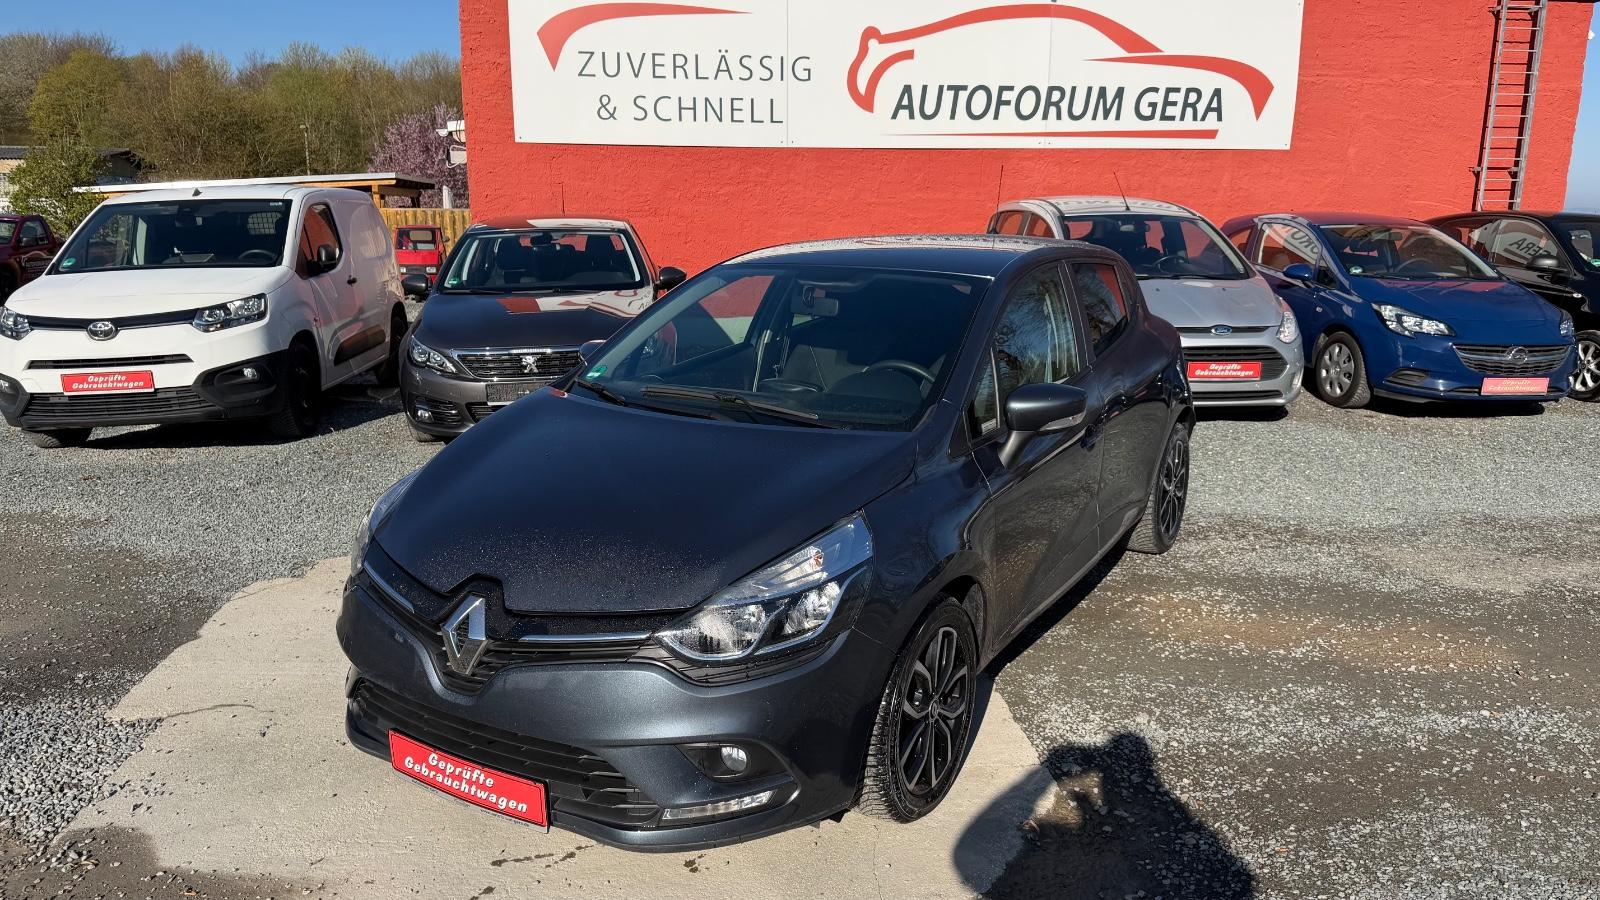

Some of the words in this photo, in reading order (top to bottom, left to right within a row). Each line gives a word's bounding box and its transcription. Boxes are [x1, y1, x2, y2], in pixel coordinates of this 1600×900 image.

[577, 49, 812, 82] ZUVERLÄSSIG
[596, 94, 618, 121] &
[633, 95, 784, 124] SCHNELL
[890, 84, 1123, 121] AUTOFORUM
[1133, 86, 1223, 122] GERA
[72, 381, 144, 389] Gebrauchtwagen
[87, 374, 127, 383] Geprüfte
[405, 757, 527, 812] Gebrauchtwagen
[429, 753, 494, 787] Geprüfte
